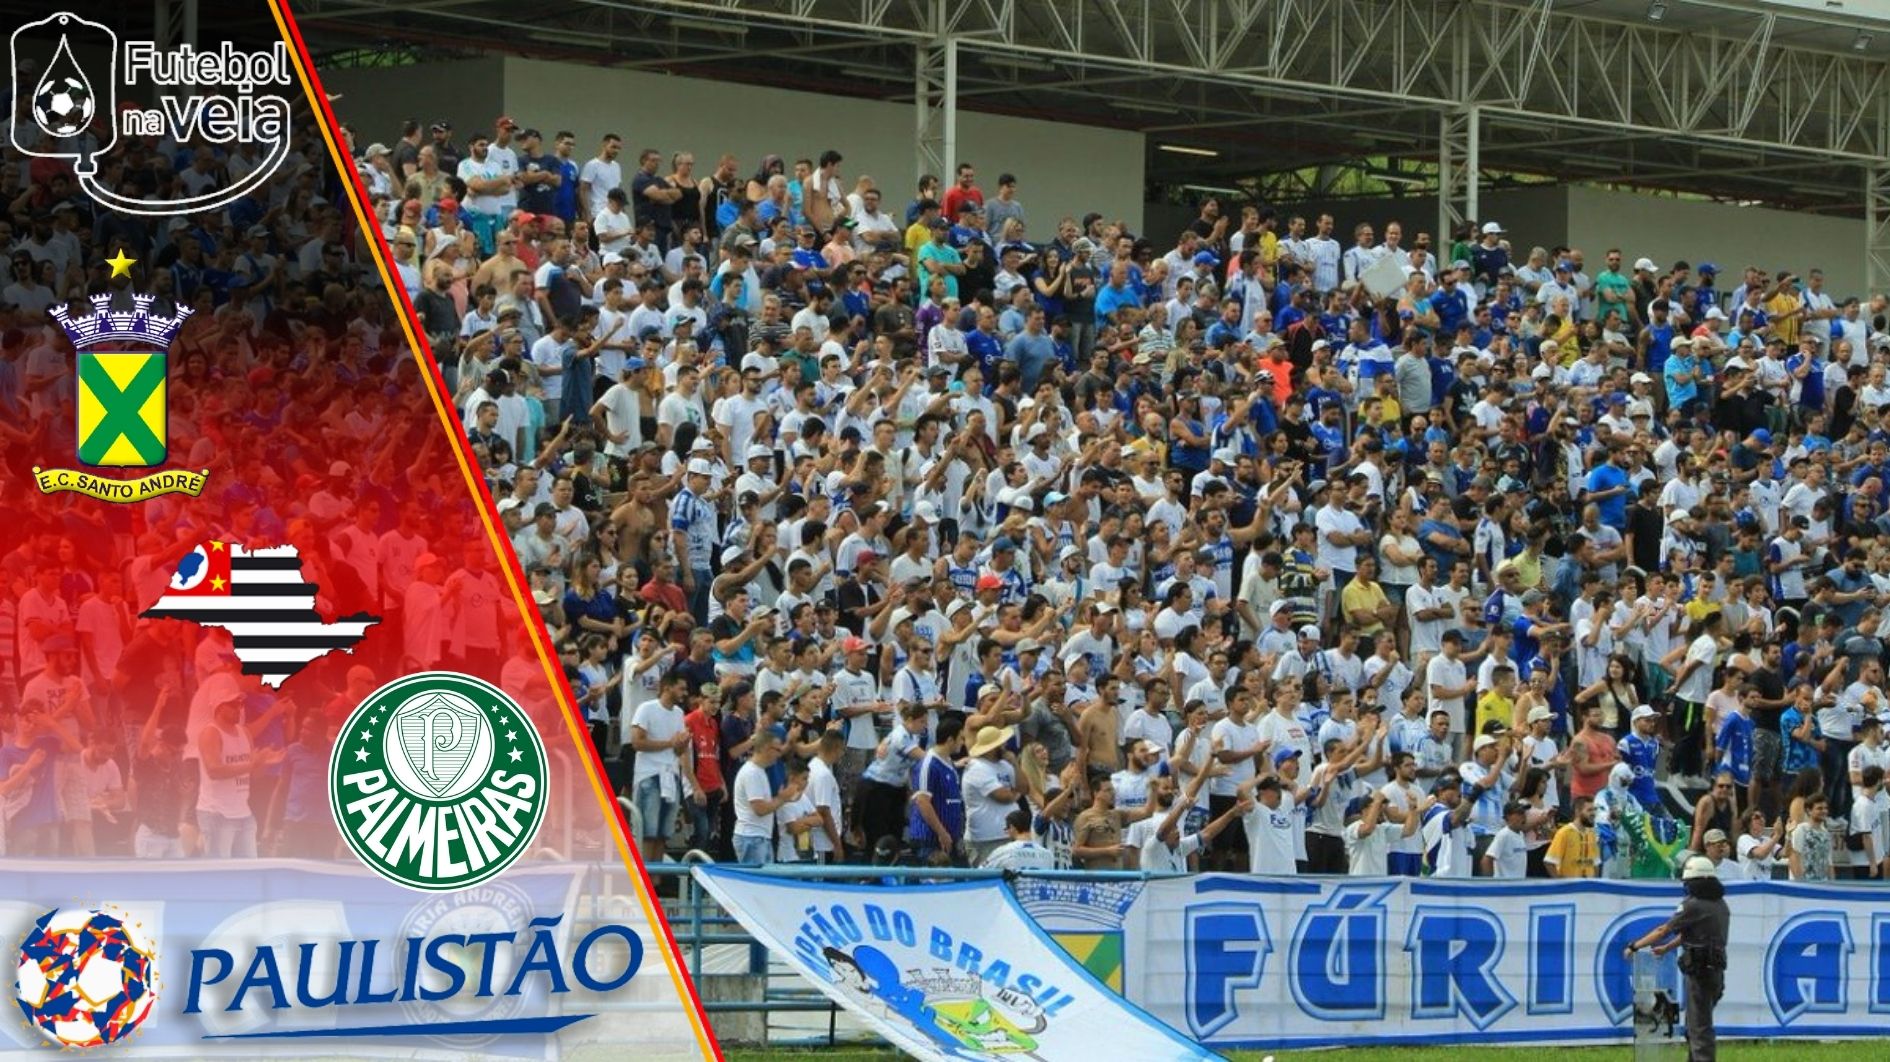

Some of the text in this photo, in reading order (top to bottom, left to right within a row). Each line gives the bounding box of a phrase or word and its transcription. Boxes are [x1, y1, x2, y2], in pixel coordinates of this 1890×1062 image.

[864, 903, 917, 948] DO
[930, 926, 1075, 1017] BRASIL
[1764, 911, 1890, 1027] A
